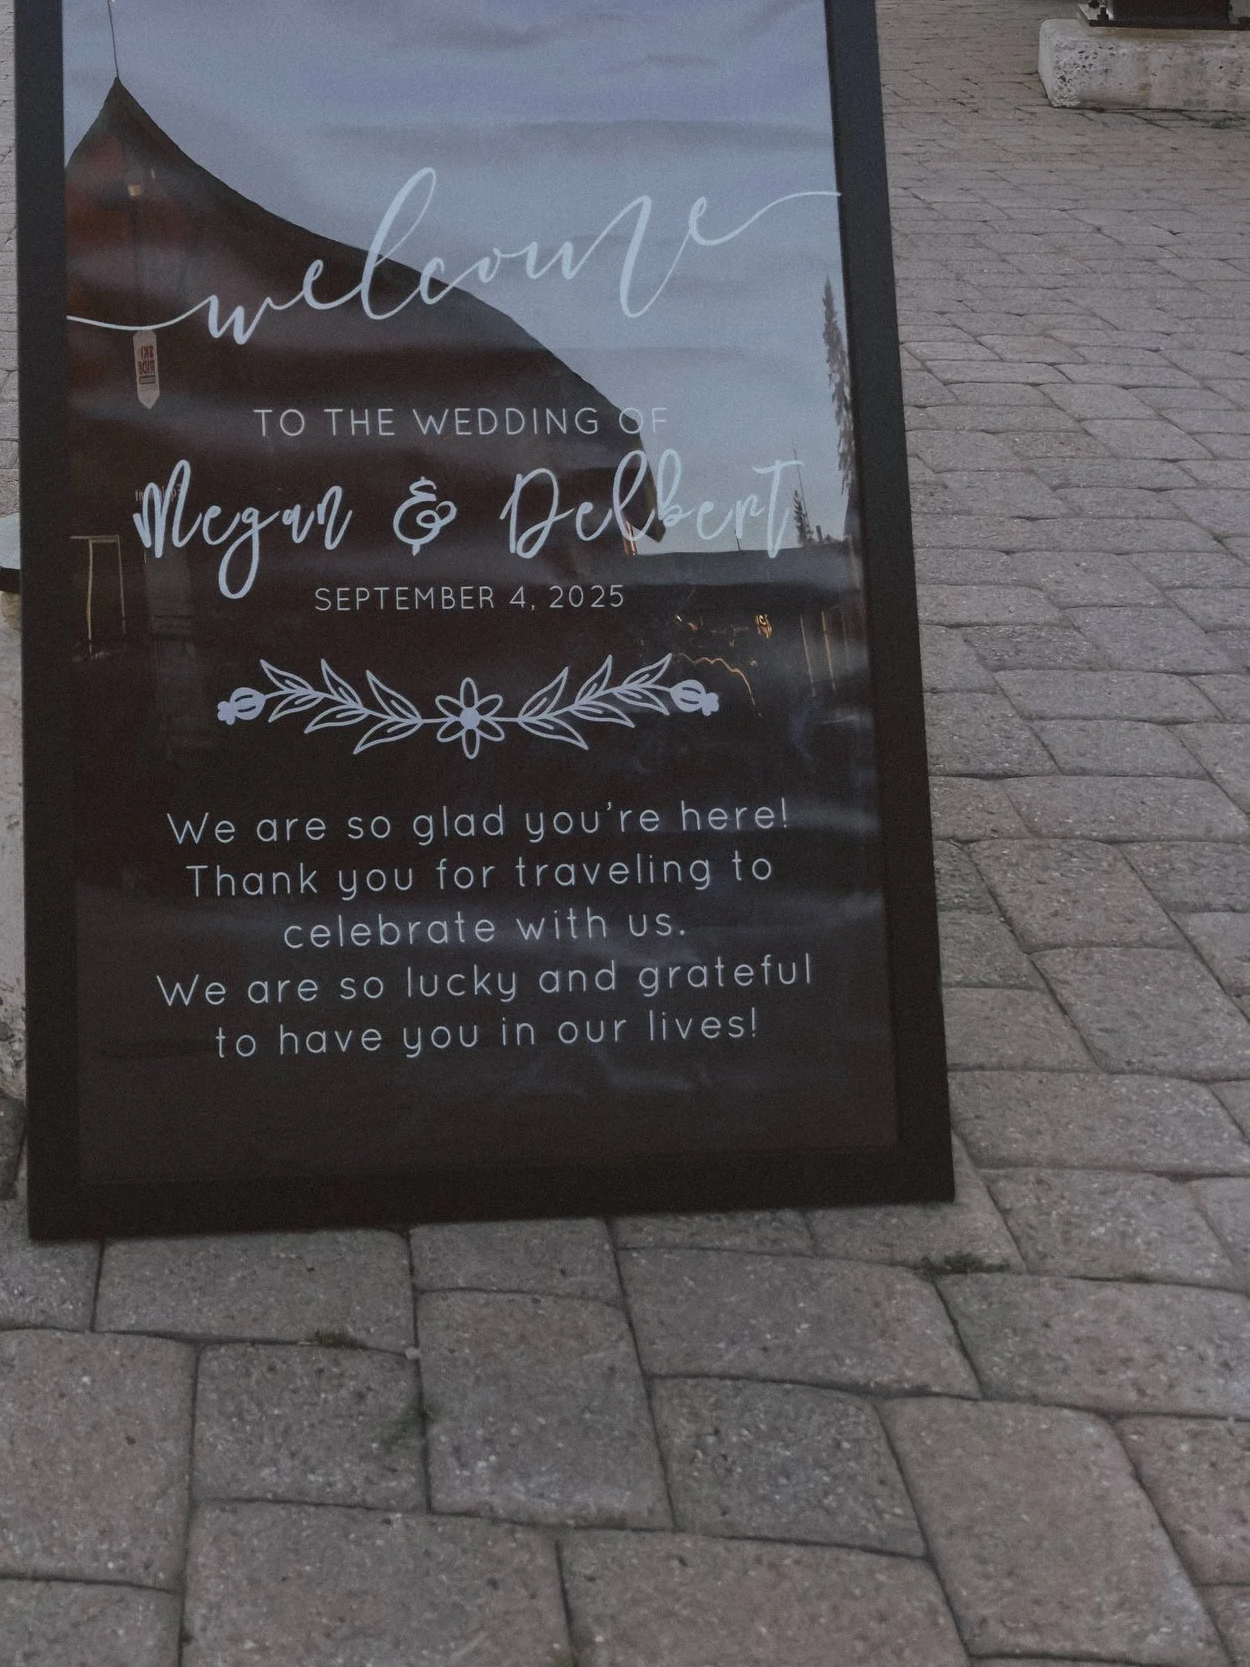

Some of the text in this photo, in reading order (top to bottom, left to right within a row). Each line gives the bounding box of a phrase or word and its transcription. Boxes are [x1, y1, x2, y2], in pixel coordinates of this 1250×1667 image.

[66, 166, 842, 346] welcome
[253, 407, 668, 438] TO THE WEDDING OF
[132, 449, 804, 600] Megan & Delbert
[314, 584, 625, 616] SEPTEMBER 4, 2025
[166, 796, 790, 847] We are so glad you're here!
[185, 849, 773, 902] Thank you for traveling to
[283, 906, 686, 950] celebrate with us.
[156, 952, 813, 1007] We are so lucky and grateful
[215, 1006, 758, 1059] to have you in our lives!
